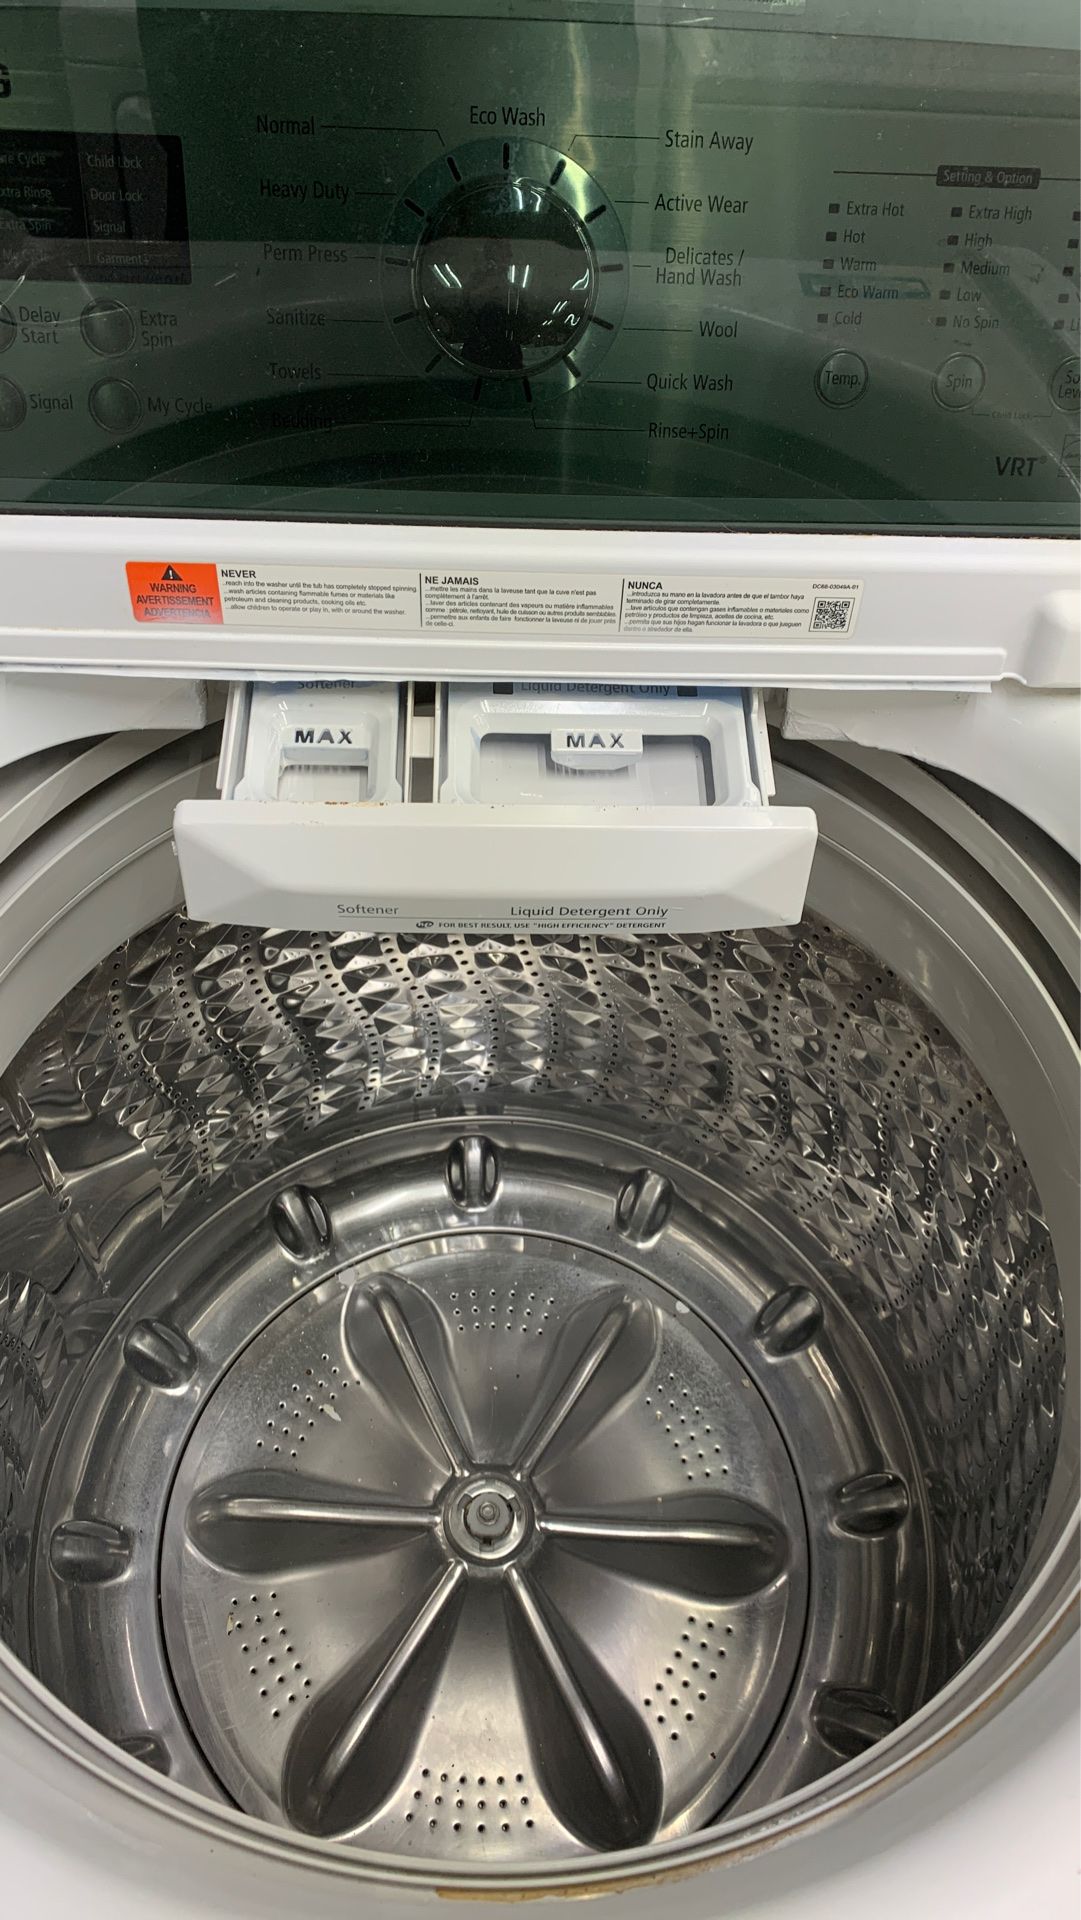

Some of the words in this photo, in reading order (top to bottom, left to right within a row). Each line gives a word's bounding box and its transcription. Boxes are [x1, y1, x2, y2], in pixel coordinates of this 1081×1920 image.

[470, 105, 497, 125] Eco
[502, 106, 545, 126] Wash
[257, 115, 314, 135] Normal
[665, 129, 703, 149] Stain
[709, 130, 754, 155] Away
[18, 154, 46, 170] Cycle
[87, 155, 114, 168] Child
[119, 156, 142, 169] Lock
[943, 171, 982, 185] Setting
[985, 172, 991, 182] &
[997, 172, 1032, 186] Option
[0, 187, 21, 198] xtra
[24, 186, 52, 198] Rinse
[91, 188, 115, 201] Door
[120, 189, 143, 201] Lock
[260, 179, 307, 203] Heavy
[313, 181, 349, 204] Duty
[654, 193, 702, 212] Active
[708, 195, 749, 213] Wear
[847, 201, 877, 216] Extra
[882, 202, 904, 216] Hot
[969, 206, 1000, 219] Extra
[1005, 206, 1032, 224] High
[29, 220, 51, 235] Spin
[94, 220, 125, 235] Signal
[844, 230, 865, 243] Hot
[965, 233, 992, 250] High
[264, 243, 303, 261] Perm
[308, 245, 348, 263] Press
[666, 246, 733, 265] Delicates
[738, 249, 744, 266] /
[840, 258, 877, 271] Warm
[961, 263, 1009, 275] Medium
[656, 267, 695, 285] Hand
[701, 268, 741, 287] Wash
[838, 287, 858, 298] Eco
[863, 287, 898, 299] Warm
[957, 290, 981, 301] Low
[19, 306, 60, 326] Delay
[141, 310, 177, 326] Extra
[266, 308, 326, 326] Sanitize
[835, 312, 862, 325] Cold
[953, 316, 969, 328] No
[974, 316, 999, 330] Spin
[21, 328, 59, 344] Start
[700, 320, 737, 337] Wool
[143, 331, 172, 350] Spin
[269, 363, 321, 379] Towels
[826, 370, 860, 387] Temp.
[647, 373, 688, 391] Quick
[693, 373, 733, 391] Wash
[946, 374, 972, 390] Spin
[30, 394, 73, 413] Signal
[148, 398, 169, 415] My
[175, 399, 211, 414] Cycle
[649, 422, 729, 443] Rinse+Spin
[221, 569, 256, 578] NEVER
[425, 576, 439, 584] NE
[441, 577, 479, 585] JAMAIS
[149, 583, 197, 593] WARNING
[628, 581, 663, 589] NUNCA
[137, 595, 214, 606] AVERTISSEMENT
[567, 683, 635, 695] Detergent
[295, 728, 352, 744] MAX
[566, 732, 624, 749] MAX
[336, 904, 399, 915] Softener
[511, 906, 554, 918] Liquid
[559, 906, 631, 918] Detergent
[635, 906, 669, 918] Only
